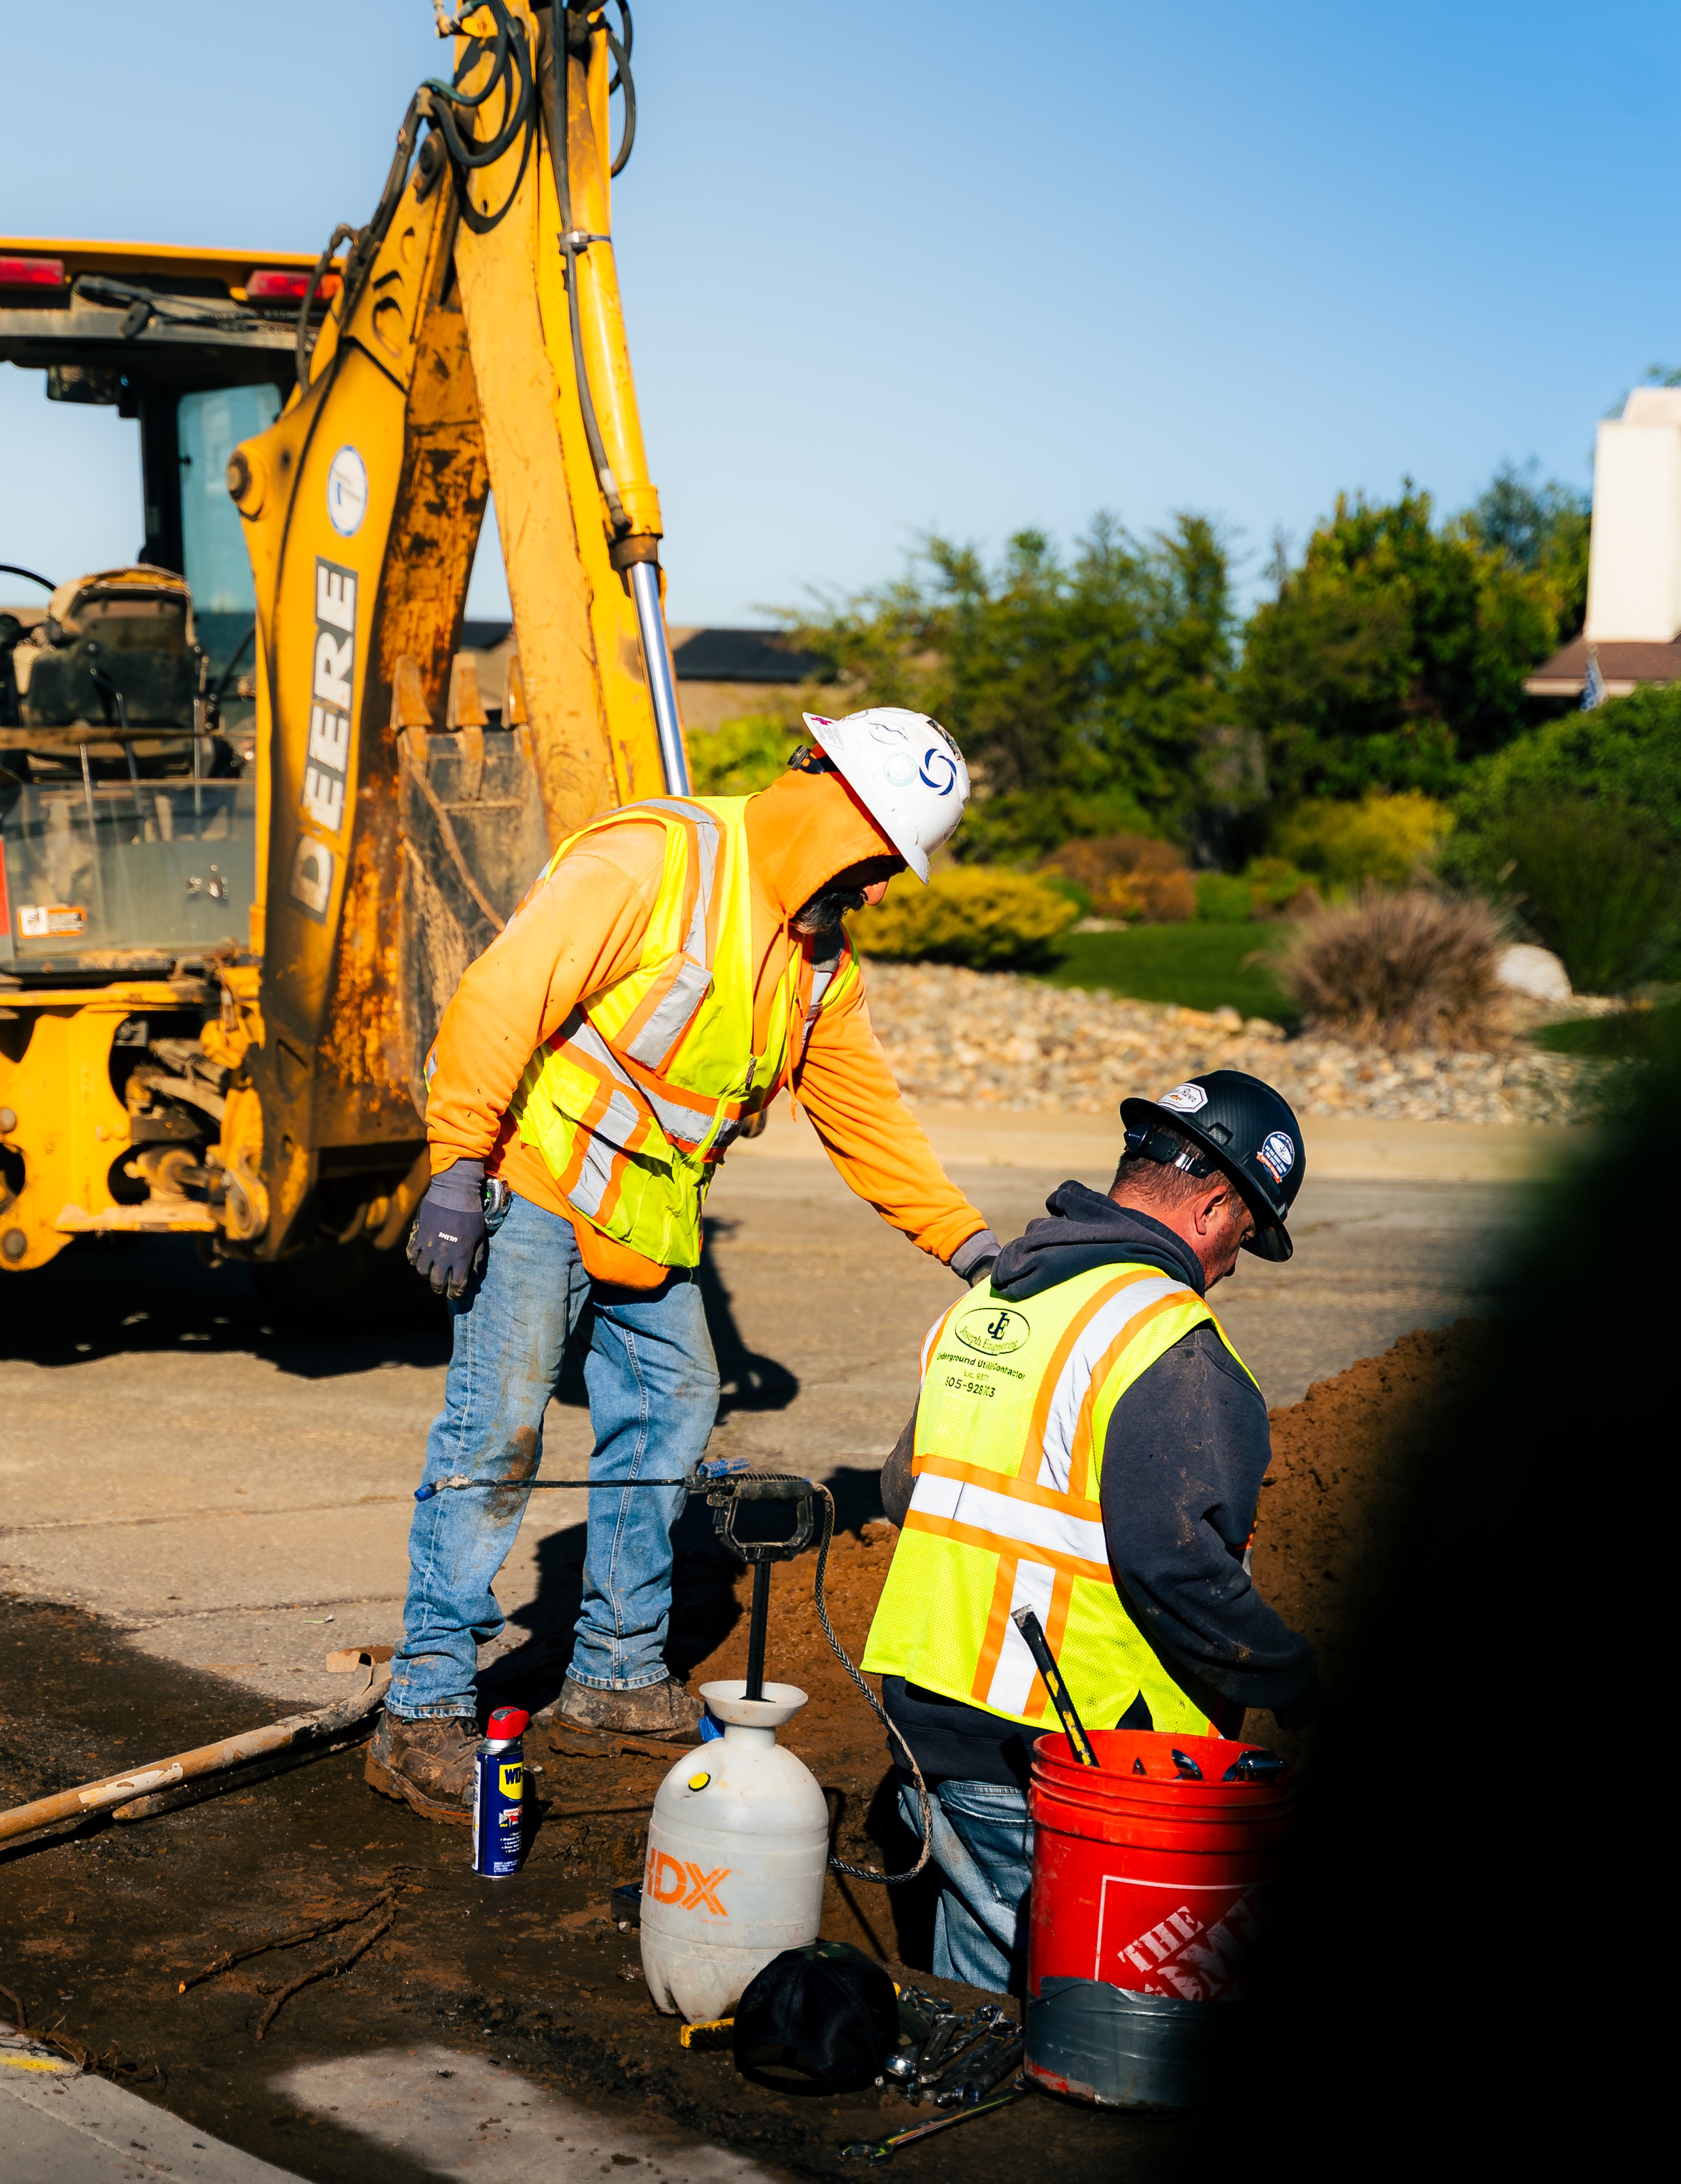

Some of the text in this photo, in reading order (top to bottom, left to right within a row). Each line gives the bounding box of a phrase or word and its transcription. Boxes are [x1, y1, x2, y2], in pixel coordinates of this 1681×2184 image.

[290, 565, 355, 915] DEERE
[437, 1232, 458, 1243] ULINE
[960, 1326, 981, 1346] Joseph
[505, 1767, 523, 1785] WD-
[1117, 1906, 1204, 1973] THE
